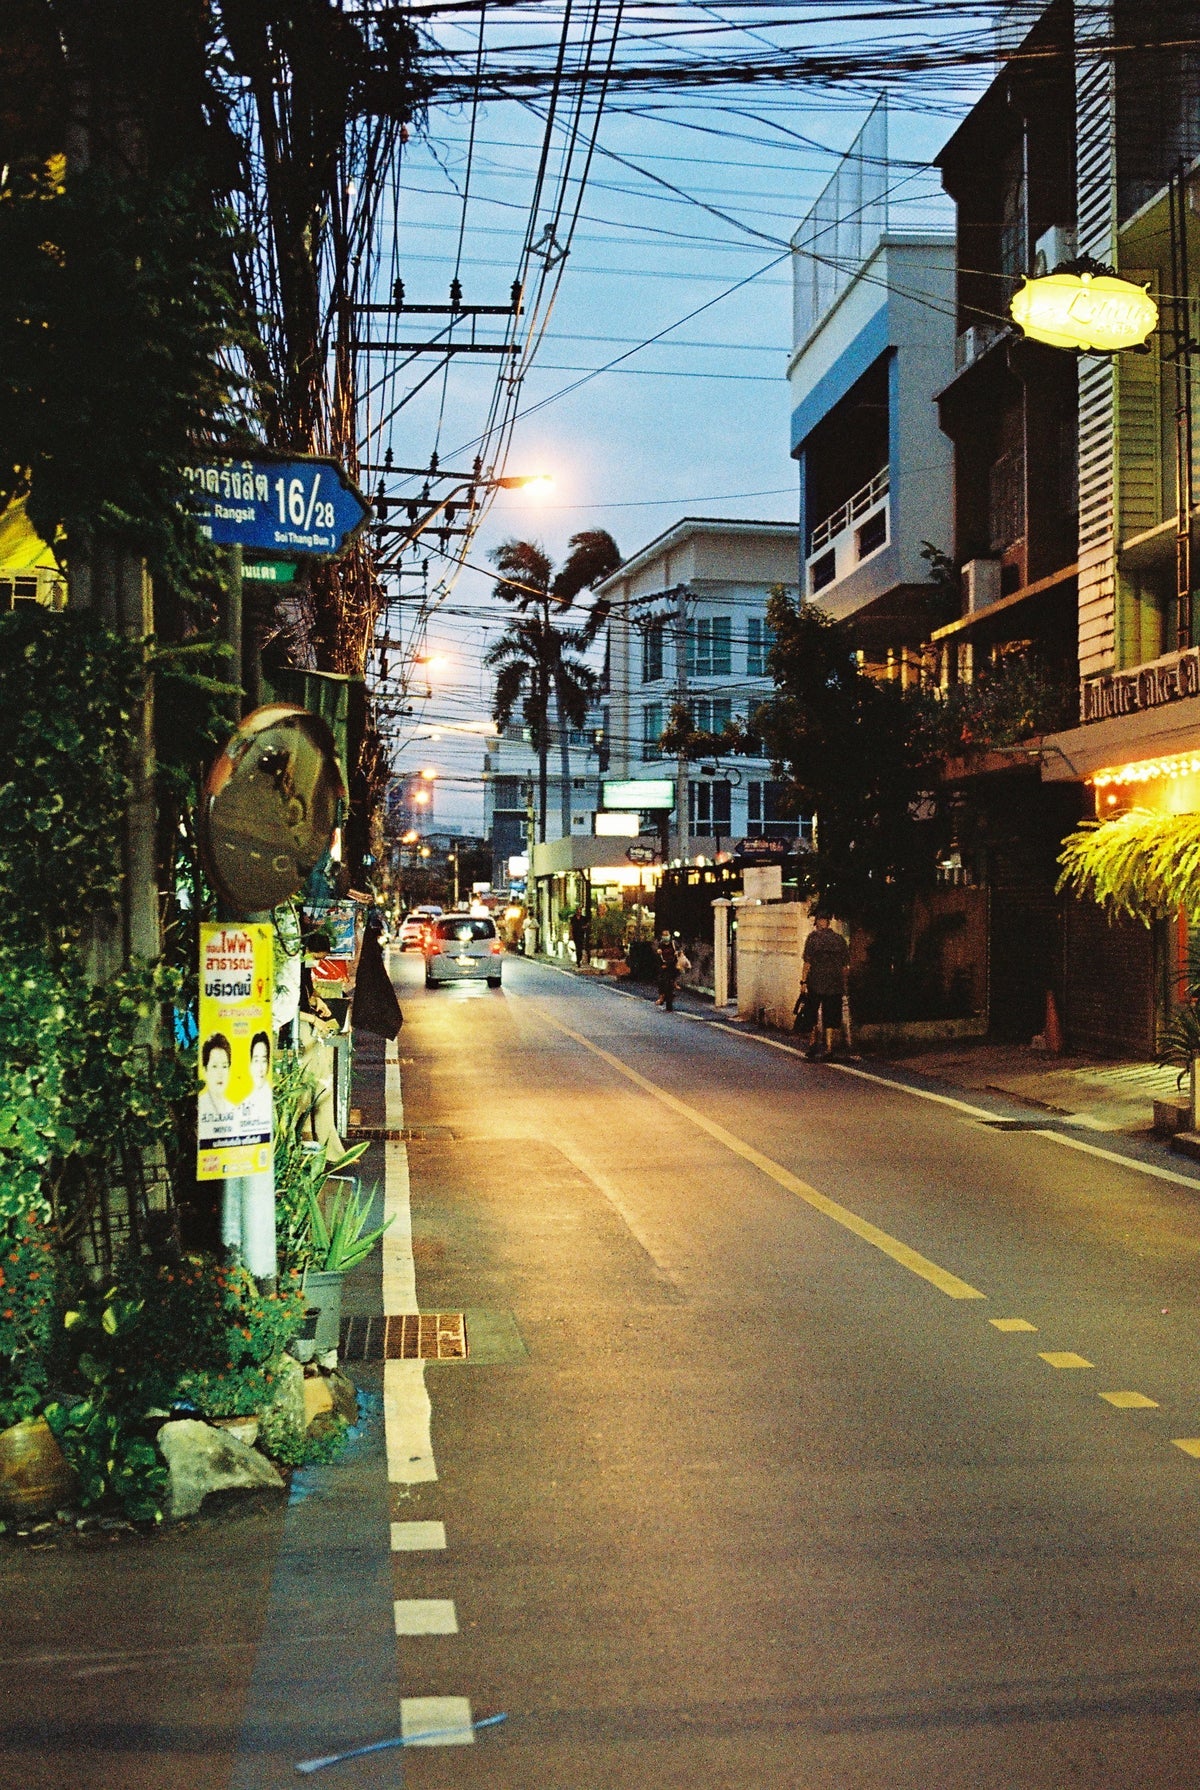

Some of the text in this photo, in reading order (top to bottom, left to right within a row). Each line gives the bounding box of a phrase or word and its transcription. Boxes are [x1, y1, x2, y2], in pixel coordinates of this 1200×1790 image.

[214, 504, 255, 523] Rangsit
[275, 473, 335, 531] 16/28
[1134, 667, 1171, 707] Cake
[206, 957, 253, 970] สาธารณะ
[205, 973, 252, 997] บริเวณนี้
